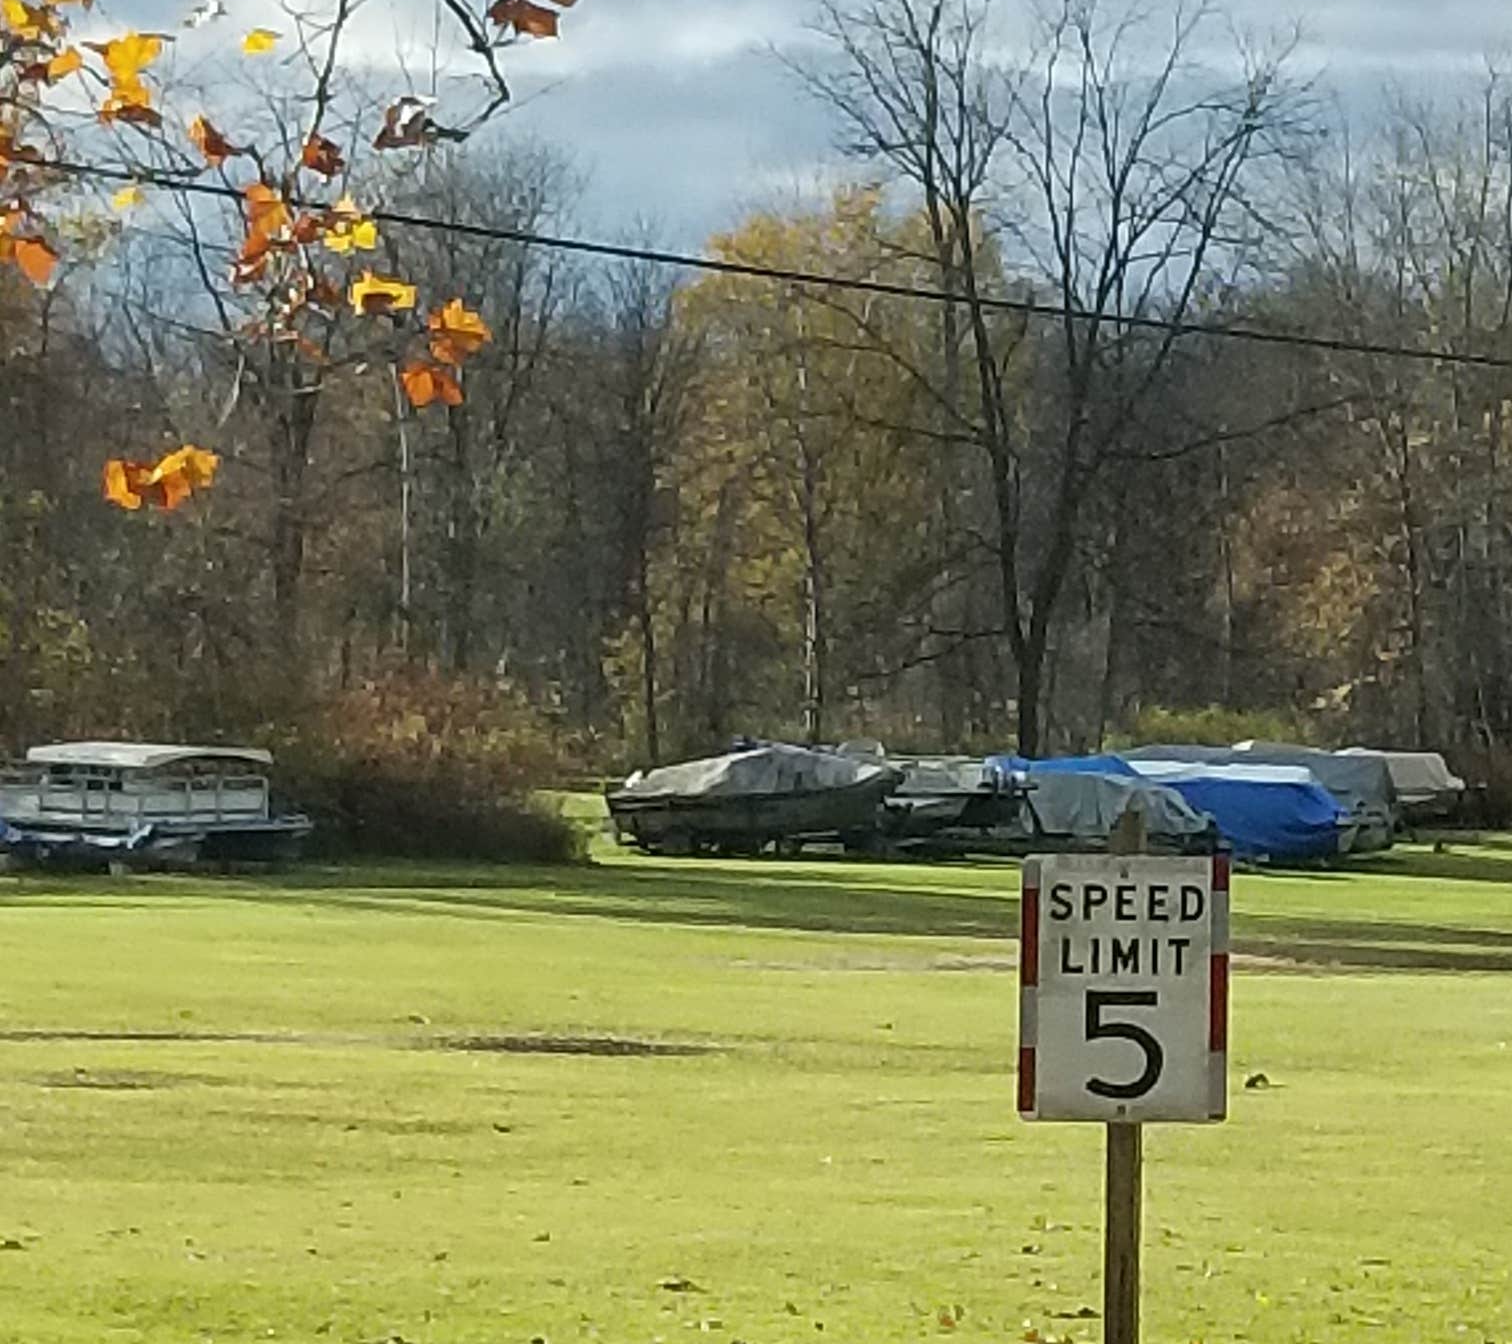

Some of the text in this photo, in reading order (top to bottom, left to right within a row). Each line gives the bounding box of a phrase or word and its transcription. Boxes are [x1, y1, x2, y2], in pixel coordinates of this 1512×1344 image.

[1050, 884, 1205, 922] SPEED
[1061, 937, 1191, 975] LIMIT
[1085, 989, 1164, 1099] 5
